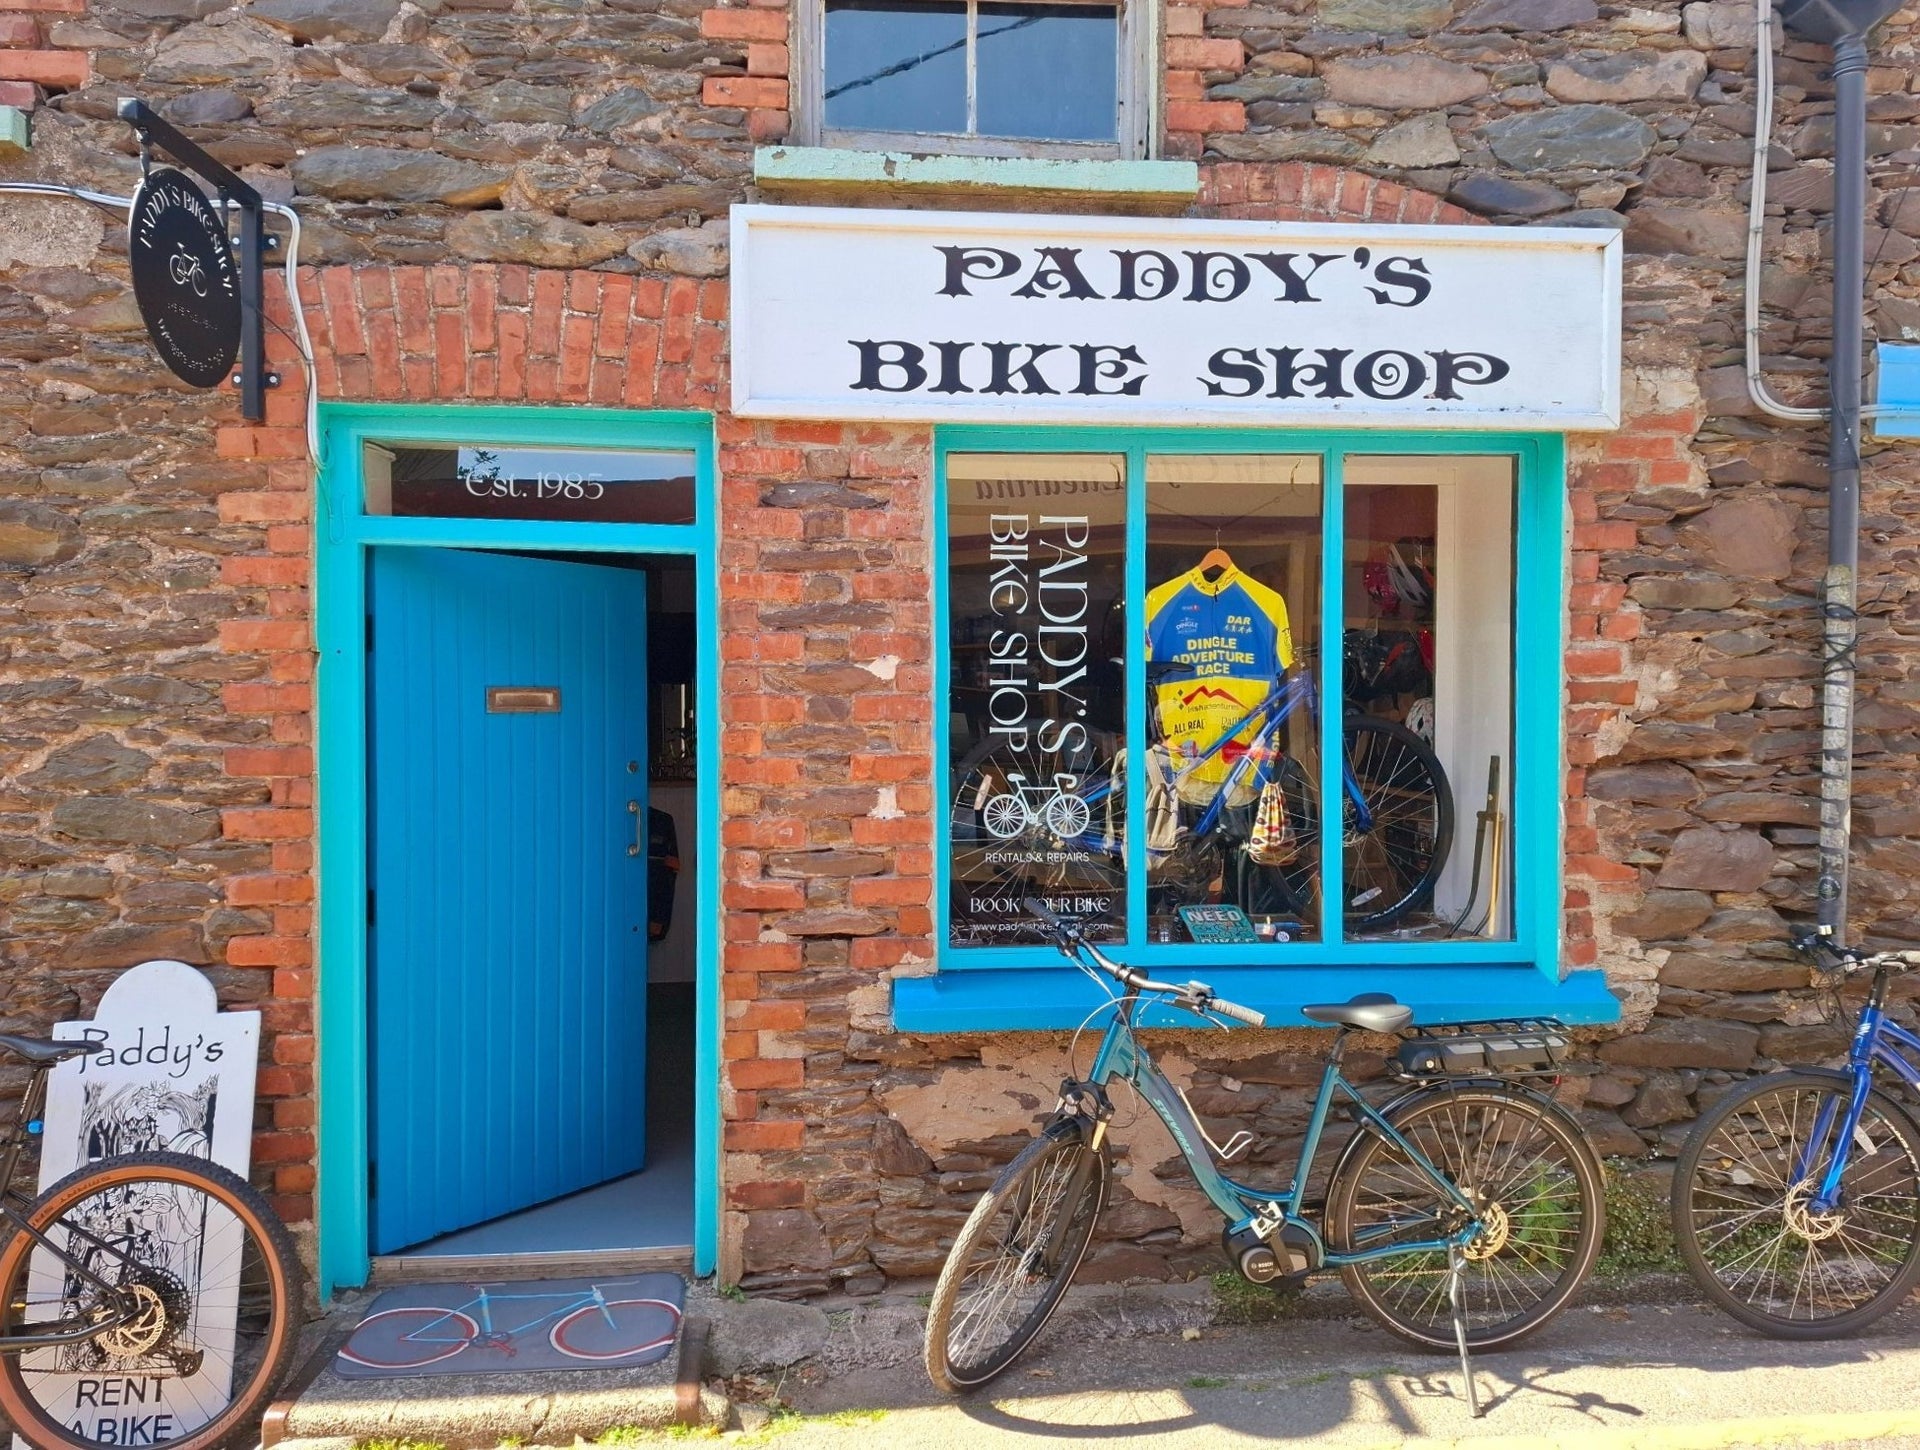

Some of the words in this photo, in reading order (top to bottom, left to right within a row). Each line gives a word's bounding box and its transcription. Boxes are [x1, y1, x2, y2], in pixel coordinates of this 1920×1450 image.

[932, 244, 1433, 308] PADDY'S
[848, 339, 1151, 397] BIKE
[1196, 346, 1511, 402] SHOP
[465, 470, 527, 498] Est.
[536, 471, 605, 500] 1985
[989, 513, 1029, 617] BIKE
[1037, 515, 1089, 754] PADDY'S
[1227, 615, 1252, 625] DAR
[1172, 649, 1255, 665] ADVENTURE
[1187, 636, 1237, 651] DINGLE
[1196, 662, 1230, 676] RACE
[989, 630, 1028, 753] SHOP
[1188, 718, 1204, 730] REAL
[985, 852, 1032, 863] RENTALS
[1046, 852, 1090, 863] REPAIRS
[970, 897, 1020, 914] BOOK
[1075, 897, 1111, 914] BIKE
[1186, 910, 1242, 922] NEED
[79, 1024, 224, 1078] Paddy's
[76, 1376, 168, 1408] RENT
[96, 1414, 173, 1446] BIKE
